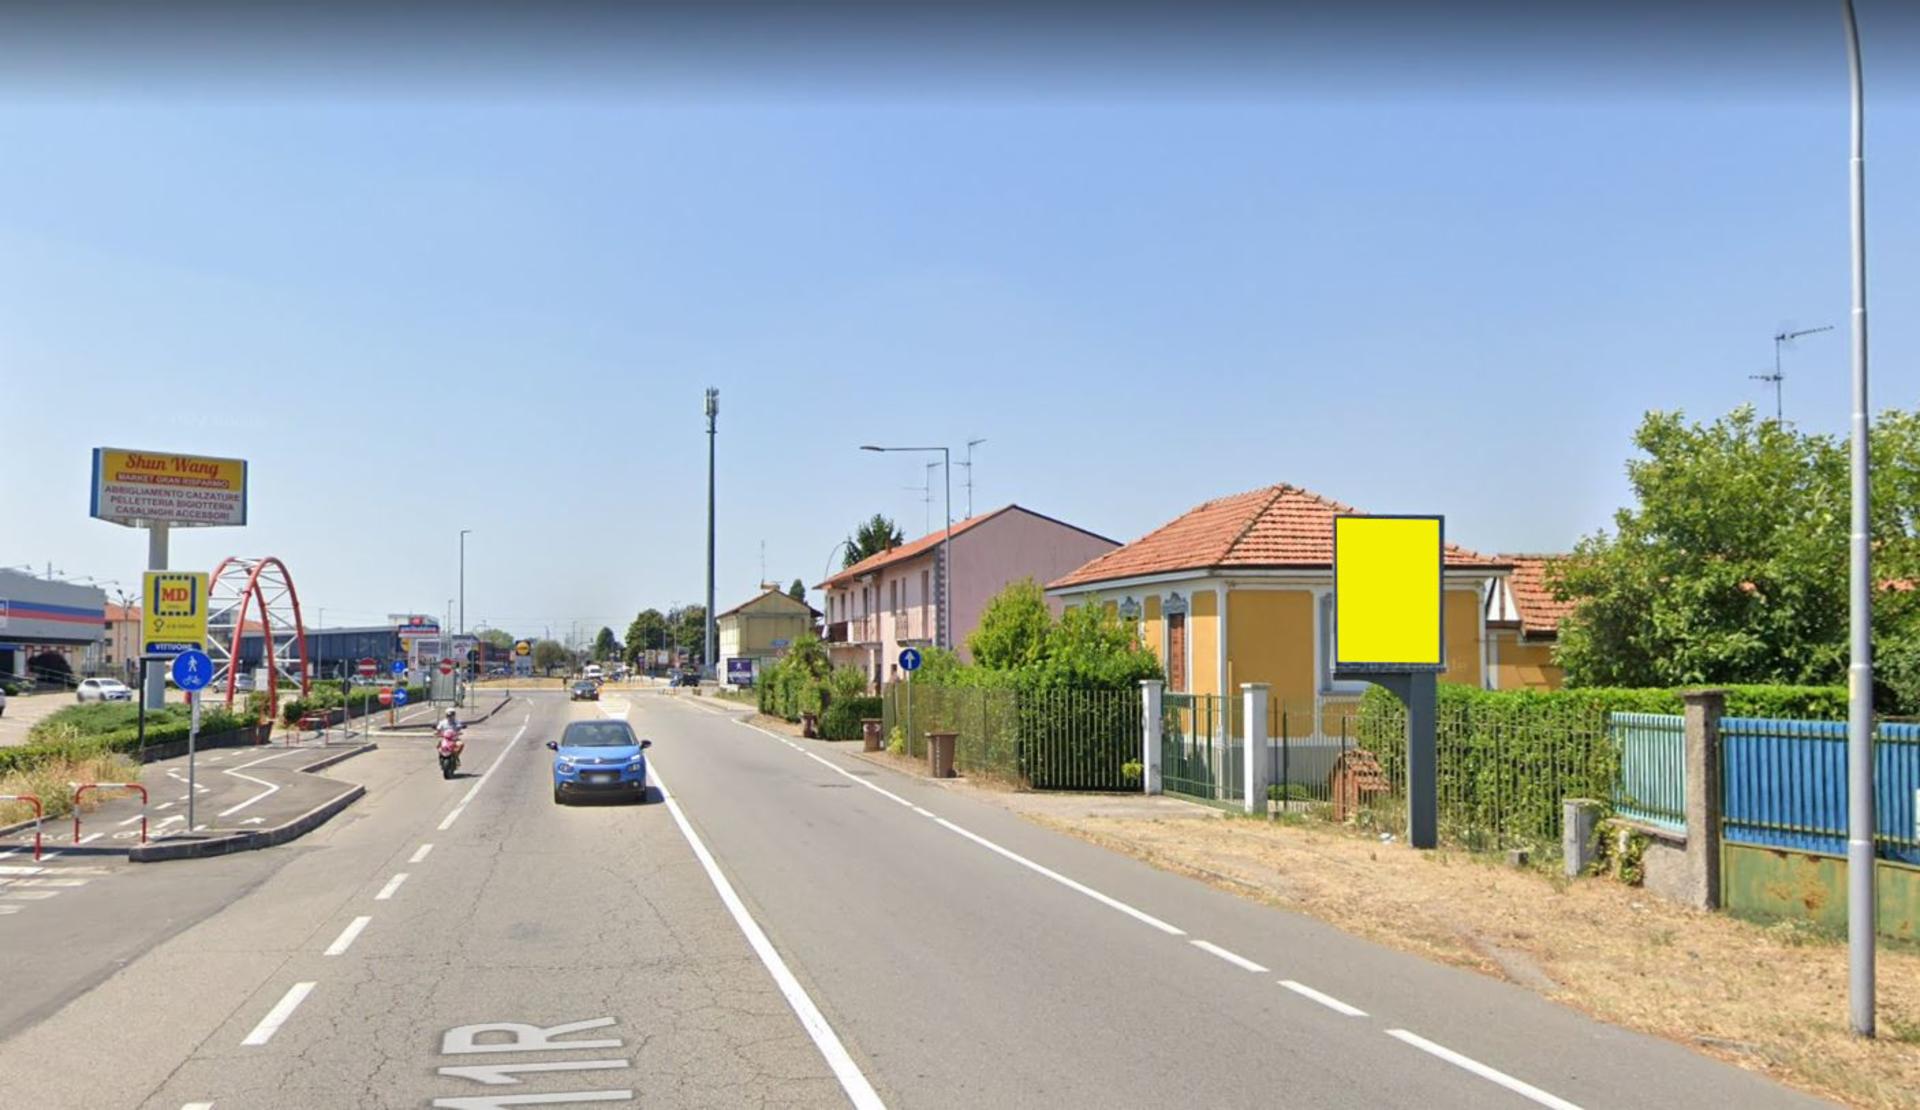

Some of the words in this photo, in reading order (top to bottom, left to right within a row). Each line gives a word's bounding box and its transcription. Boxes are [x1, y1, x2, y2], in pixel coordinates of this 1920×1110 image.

[125, 453, 167, 471] Shun
[171, 457, 219, 478] Wang
[110, 495, 174, 507] PELLETTERIA
[176, 499, 235, 511] BIGIOTTERIA
[185, 491, 240, 502] CALZATURE
[115, 505, 174, 517] CASALINGHI
[175, 510, 230, 521] ACCESSORI
[161, 587, 188, 602] MD
